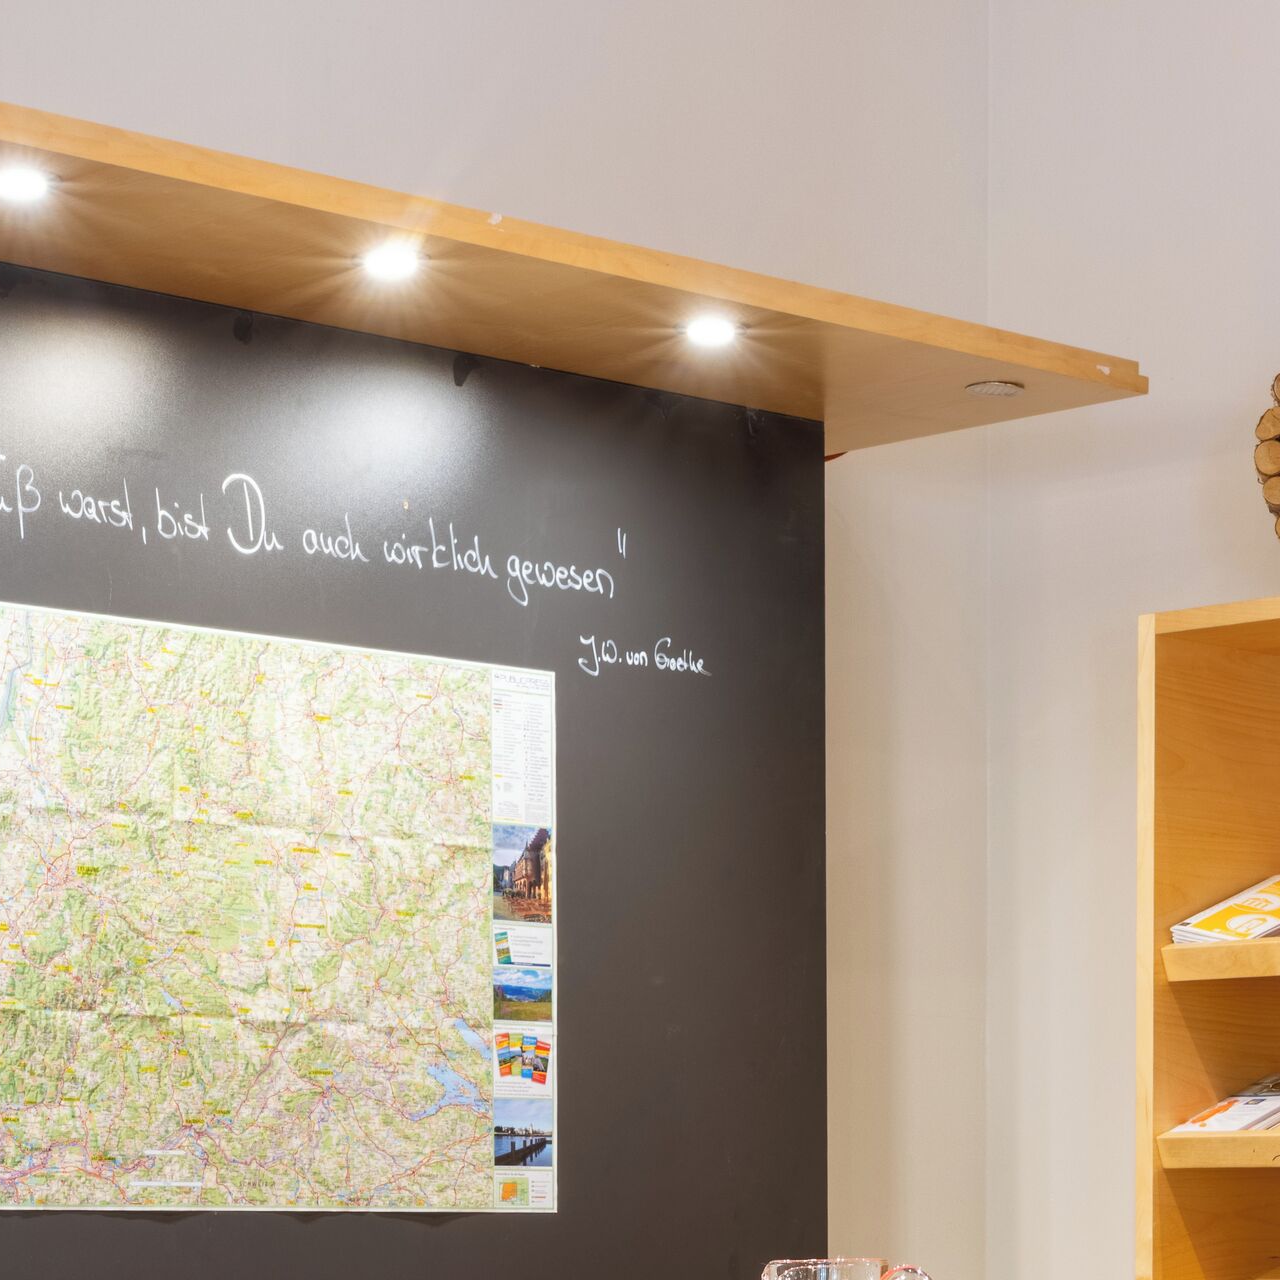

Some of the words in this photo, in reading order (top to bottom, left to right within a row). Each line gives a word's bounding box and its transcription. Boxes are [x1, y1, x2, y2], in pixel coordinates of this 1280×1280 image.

[155, 486, 210, 541] bist
[221, 473, 284, 555] Du
[302, 512, 370, 563] auch
[383, 516, 499, 580] wirklich
[626, 648, 648, 668] von
